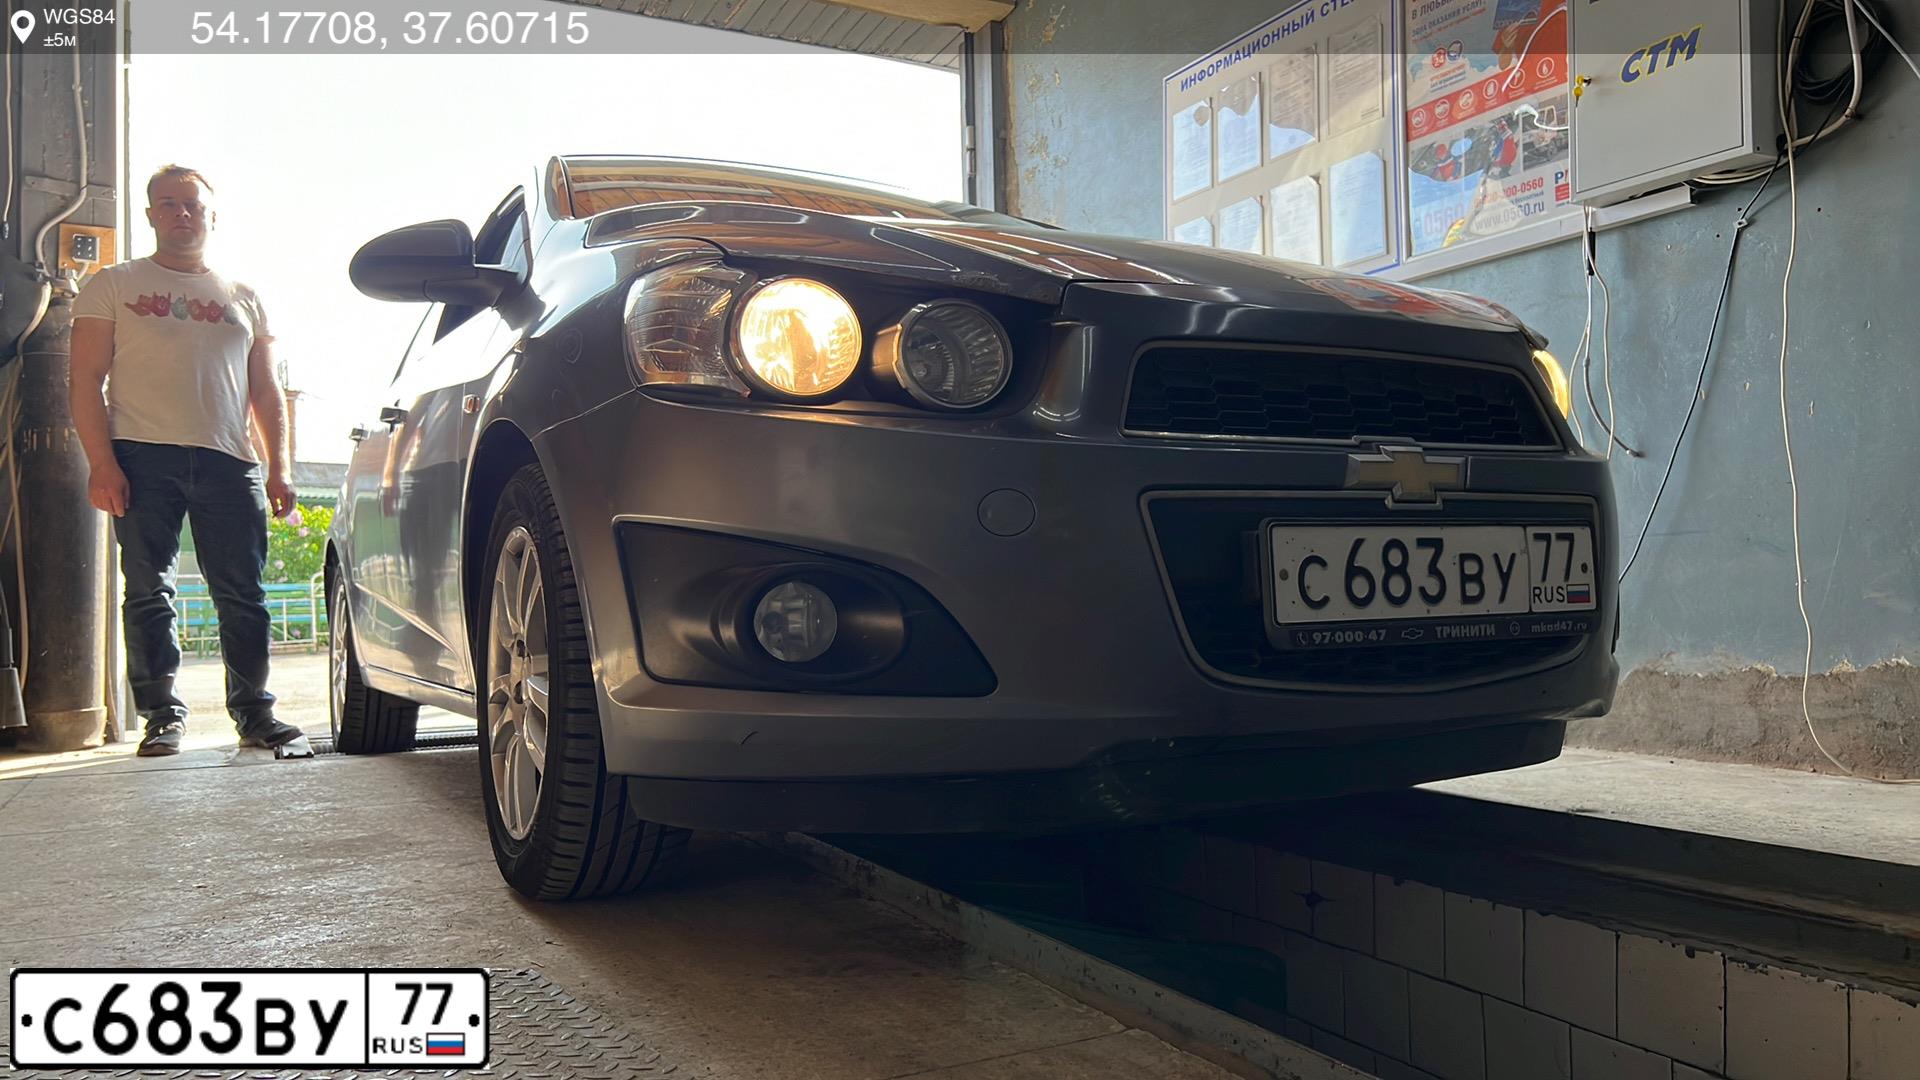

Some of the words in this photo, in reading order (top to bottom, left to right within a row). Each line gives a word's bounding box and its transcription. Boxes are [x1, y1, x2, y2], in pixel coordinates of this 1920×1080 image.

[1180, 8, 1316, 92] ИНФОРМАЦИОННЫЙ
[1621, 26, 1701, 83] СТМ
[1475, 202, 1544, 230] www.0560.ru
[1297, 537, 1516, 609] С683ВУ
[1532, 532, 1575, 582] 77
[1532, 586, 1566, 604] RUS
[1435, 624, 1496, 639] ТРИНИТИ
[1531, 621, 1588, 633] mkad47.ru
